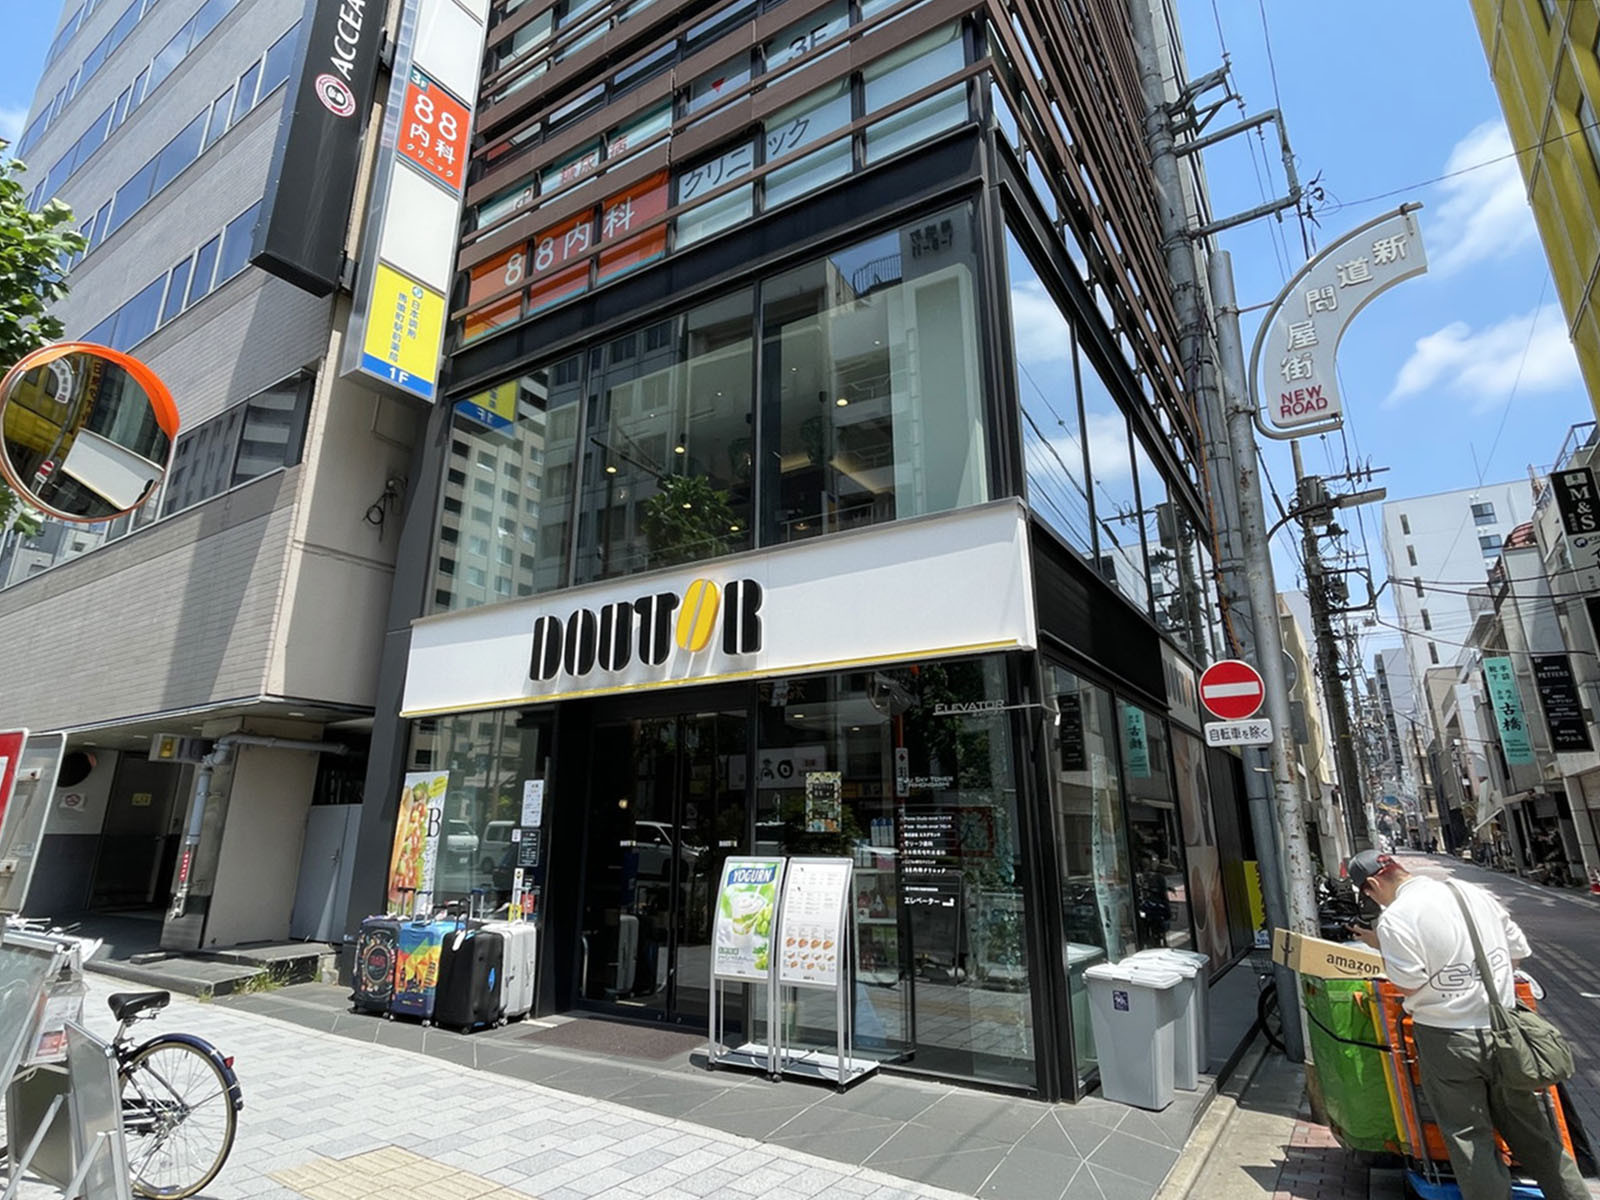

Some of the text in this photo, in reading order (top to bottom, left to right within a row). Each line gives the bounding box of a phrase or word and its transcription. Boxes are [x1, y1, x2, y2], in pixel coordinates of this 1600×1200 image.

[414, 94, 457, 141] 88
[409, 123, 456, 165] 内科
[1280, 234, 1407, 383] 新道問屋街
[389, 367, 410, 384] 1F
[1281, 385, 1322, 404] NEW
[1280, 397, 1328, 418] ROAD
[529, 578, 764, 681] DOUTOR
[935, 700, 1004, 713] ELEVATOR
[1209, 725, 1269, 741] 自転車を除く
[1326, 953, 1380, 975] amazon
